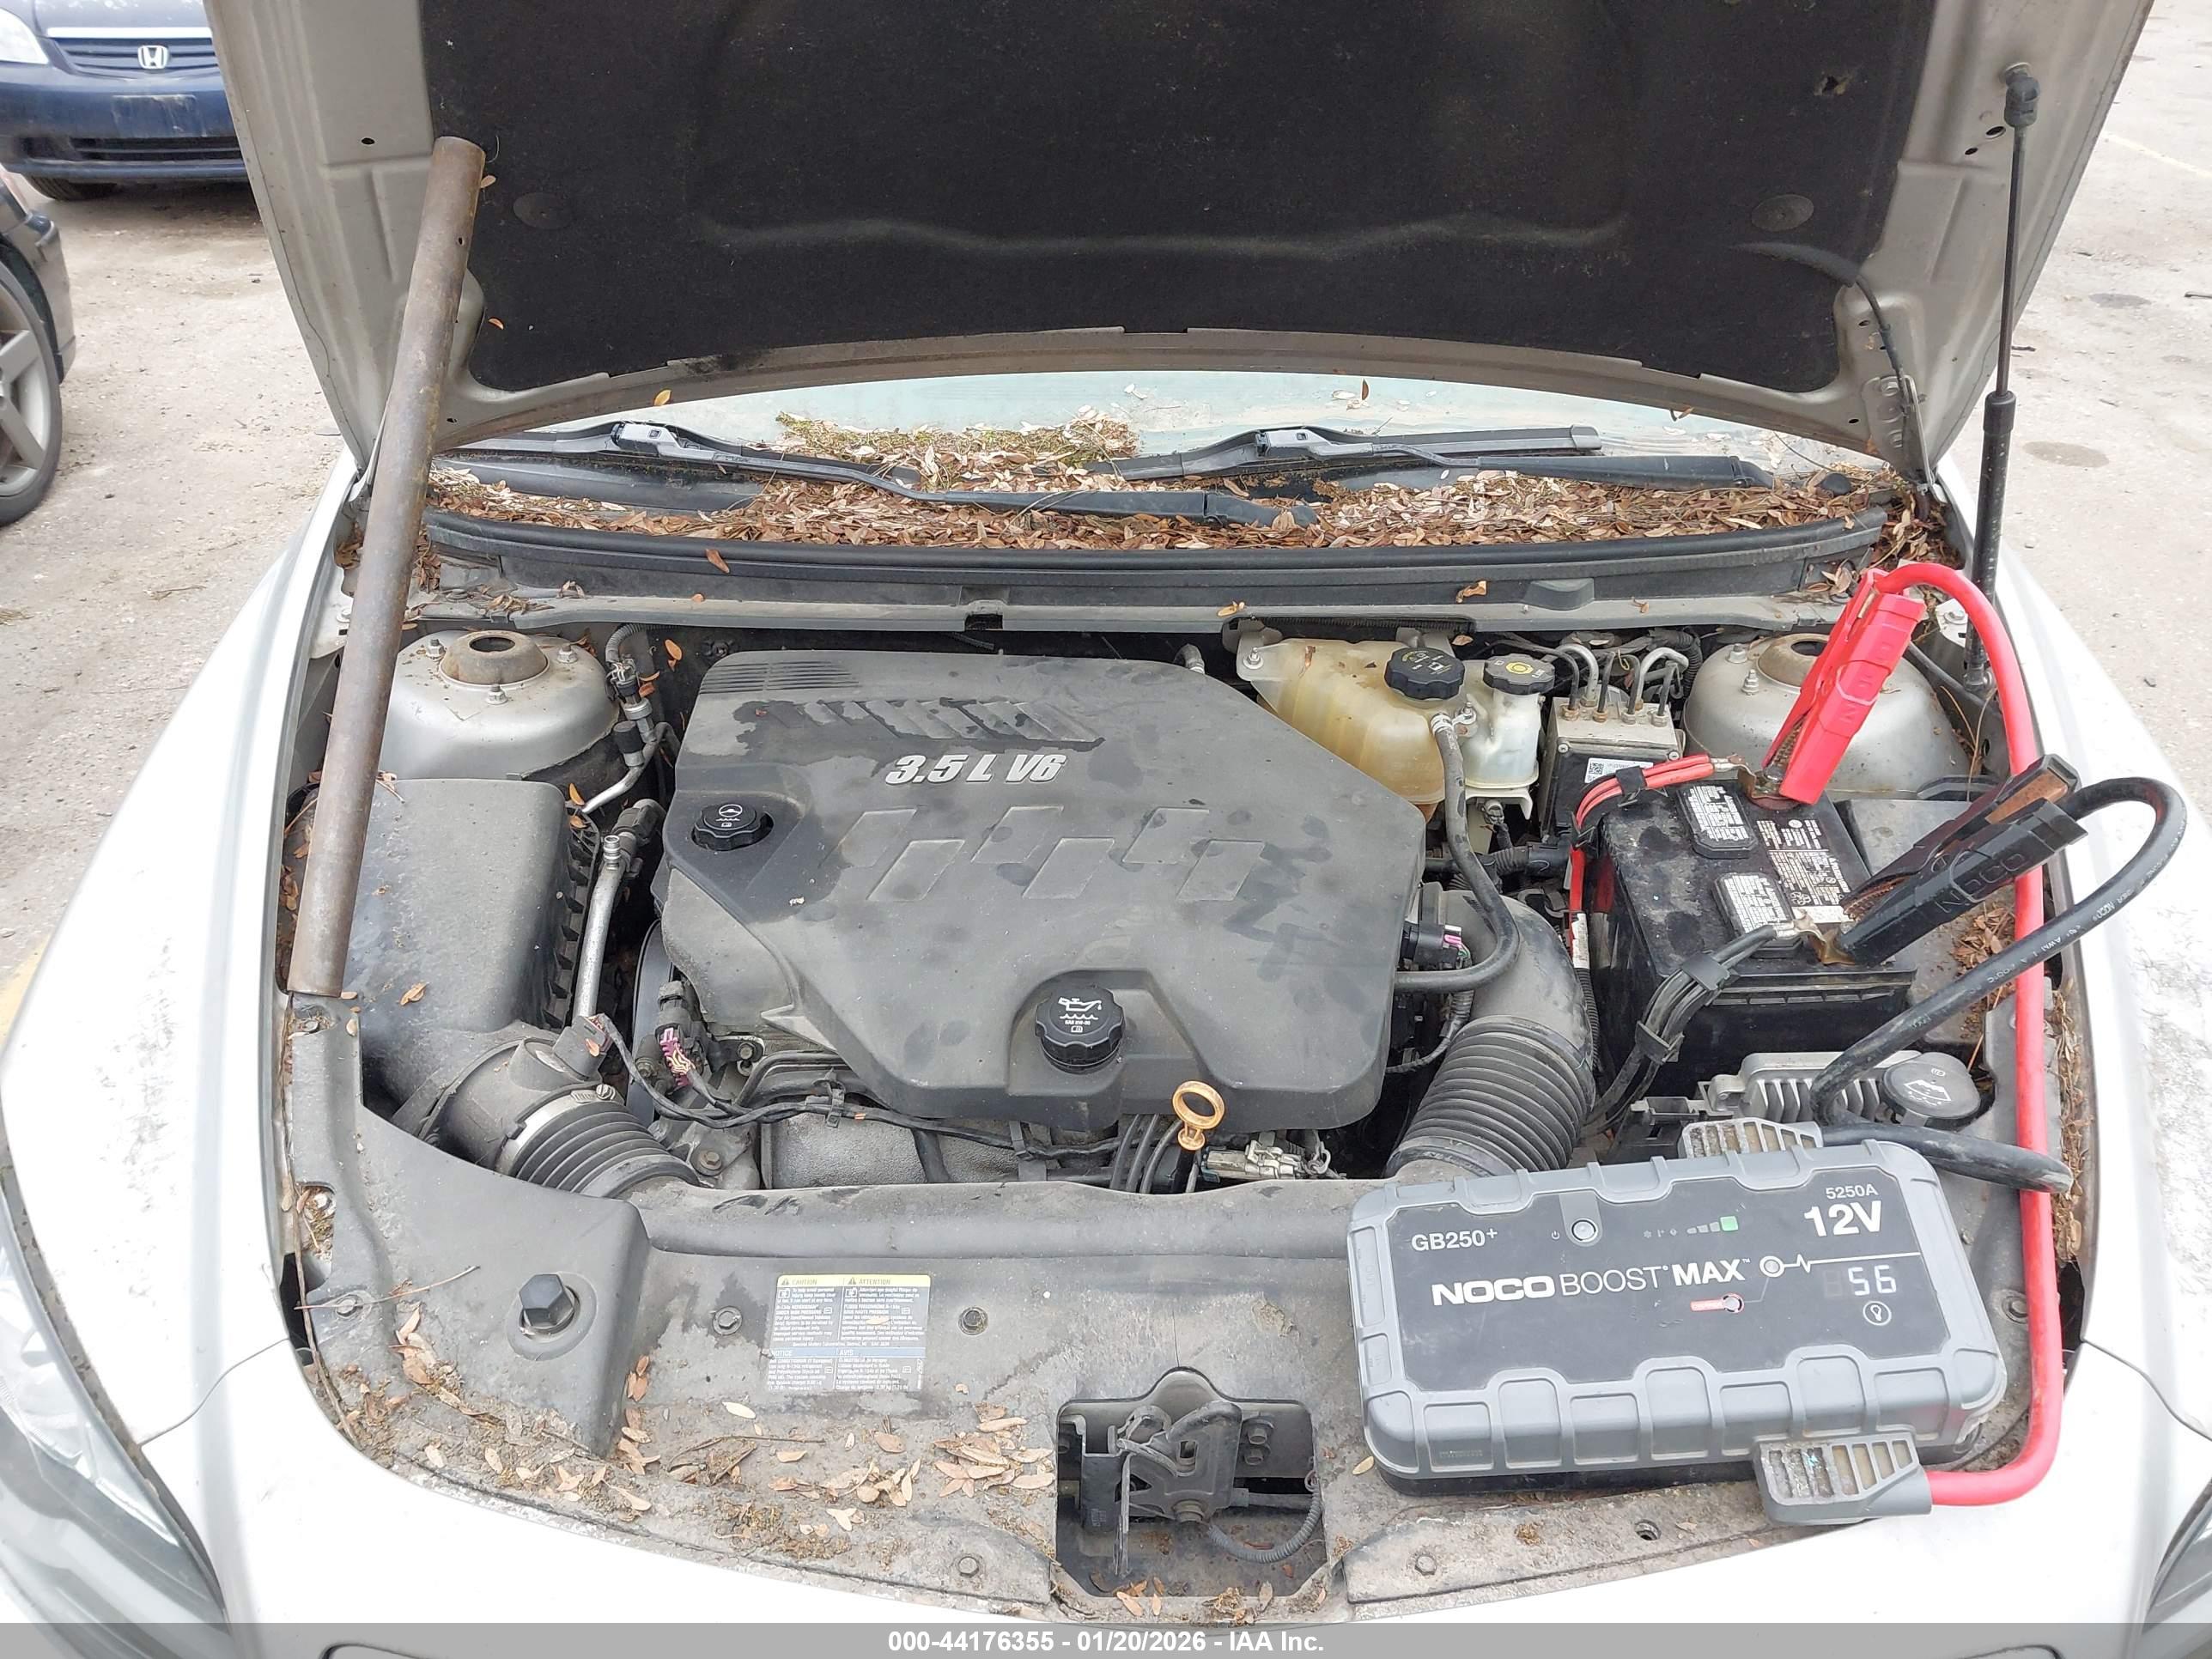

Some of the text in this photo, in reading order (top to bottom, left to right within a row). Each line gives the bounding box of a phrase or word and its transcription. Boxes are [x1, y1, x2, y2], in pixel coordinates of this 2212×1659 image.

[885, 754, 1067, 785] 3.5 L V6
[1826, 1183, 1879, 1200] 5250A
[1802, 1200, 1883, 1237] 12V
[1411, 1227, 1498, 1252] GB250+
[791, 1278, 818, 1286] CAUTION
[858, 1278, 891, 1286] ATTENTION
[1431, 1274, 1556, 1306] NOCO
[1847, 1264, 1898, 1297] 56
